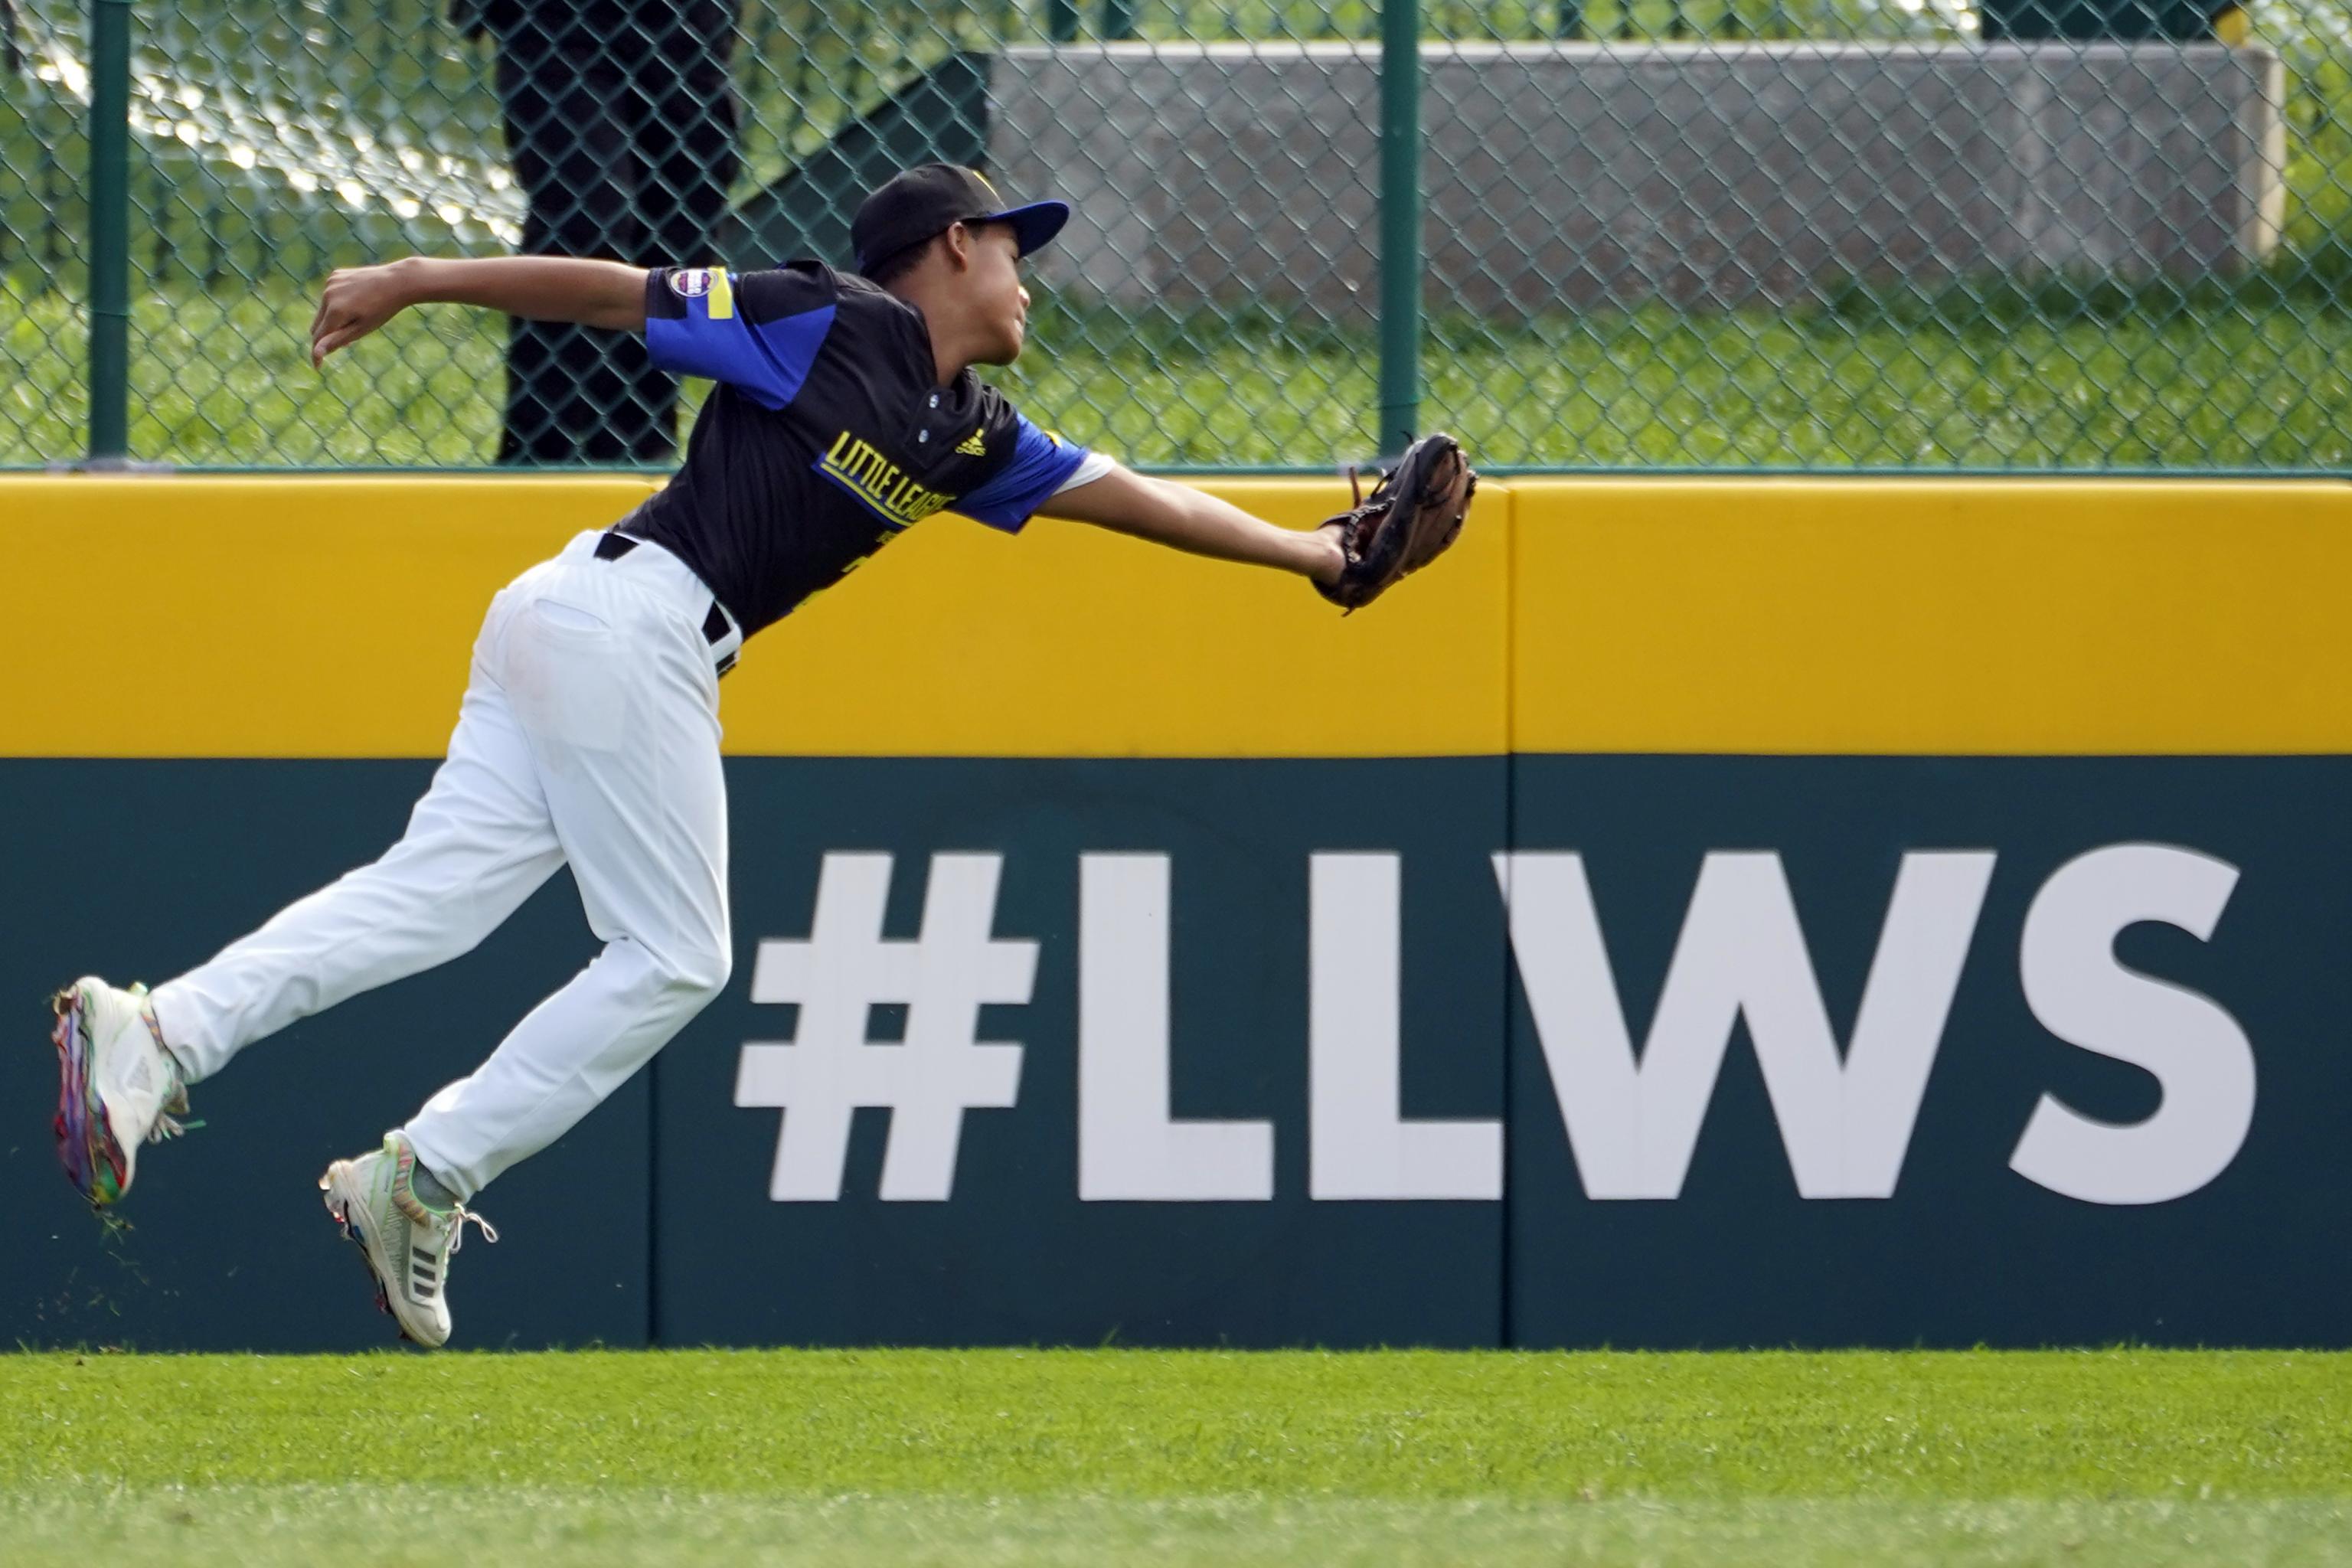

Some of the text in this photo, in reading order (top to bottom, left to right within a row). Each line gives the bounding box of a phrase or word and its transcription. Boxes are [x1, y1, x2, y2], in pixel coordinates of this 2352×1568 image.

[825, 430, 956, 521] LITTLE LEAG
[735, 844, 2256, 1205] #LLWS
